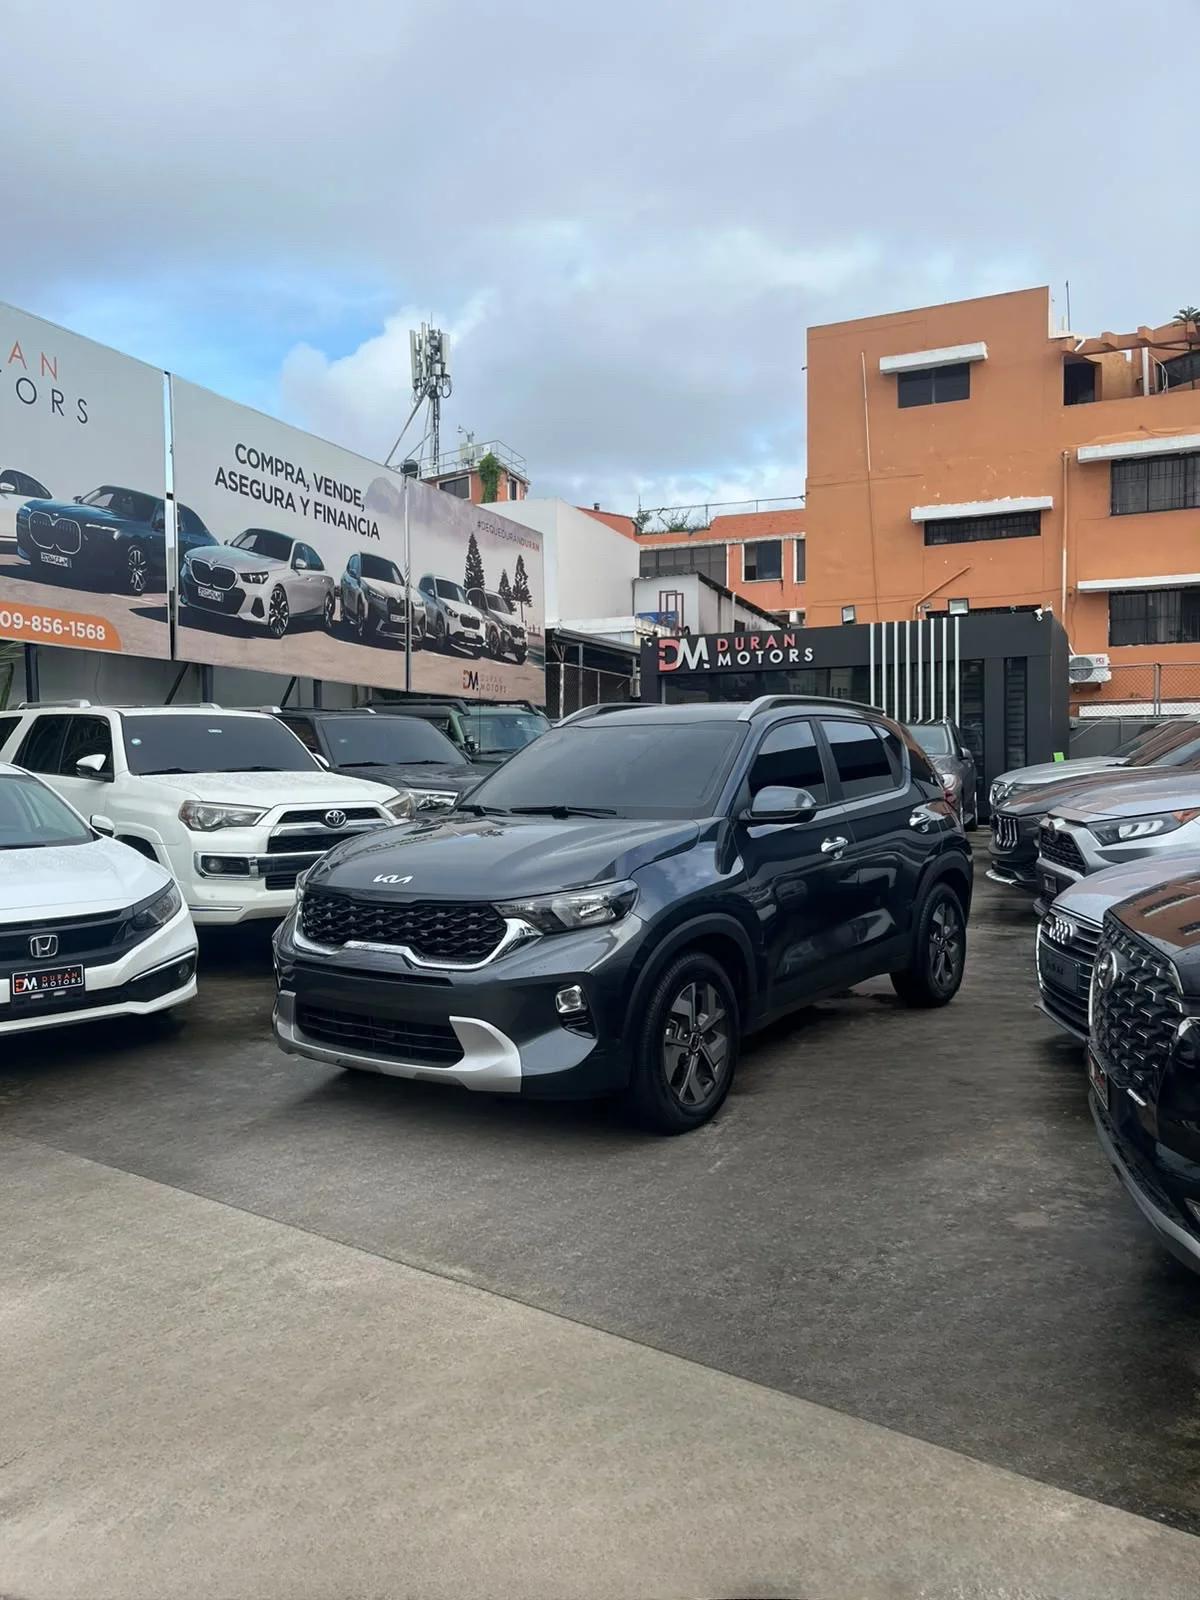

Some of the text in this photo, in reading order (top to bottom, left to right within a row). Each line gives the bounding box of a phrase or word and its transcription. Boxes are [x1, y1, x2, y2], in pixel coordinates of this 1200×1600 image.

[0, 369, 88, 424] ORS
[234, 443, 365, 512] COMPRA, VENDE,
[215, 466, 380, 541] ASEGURA Y FINANCIA
[0, 610, 106, 641] 09-856-1568
[717, 633, 796, 651] DURAN
[717, 648, 813, 667] MOTORS
[42, 972, 78, 982] DURAN
[42, 977, 81, 988] MOTORS
